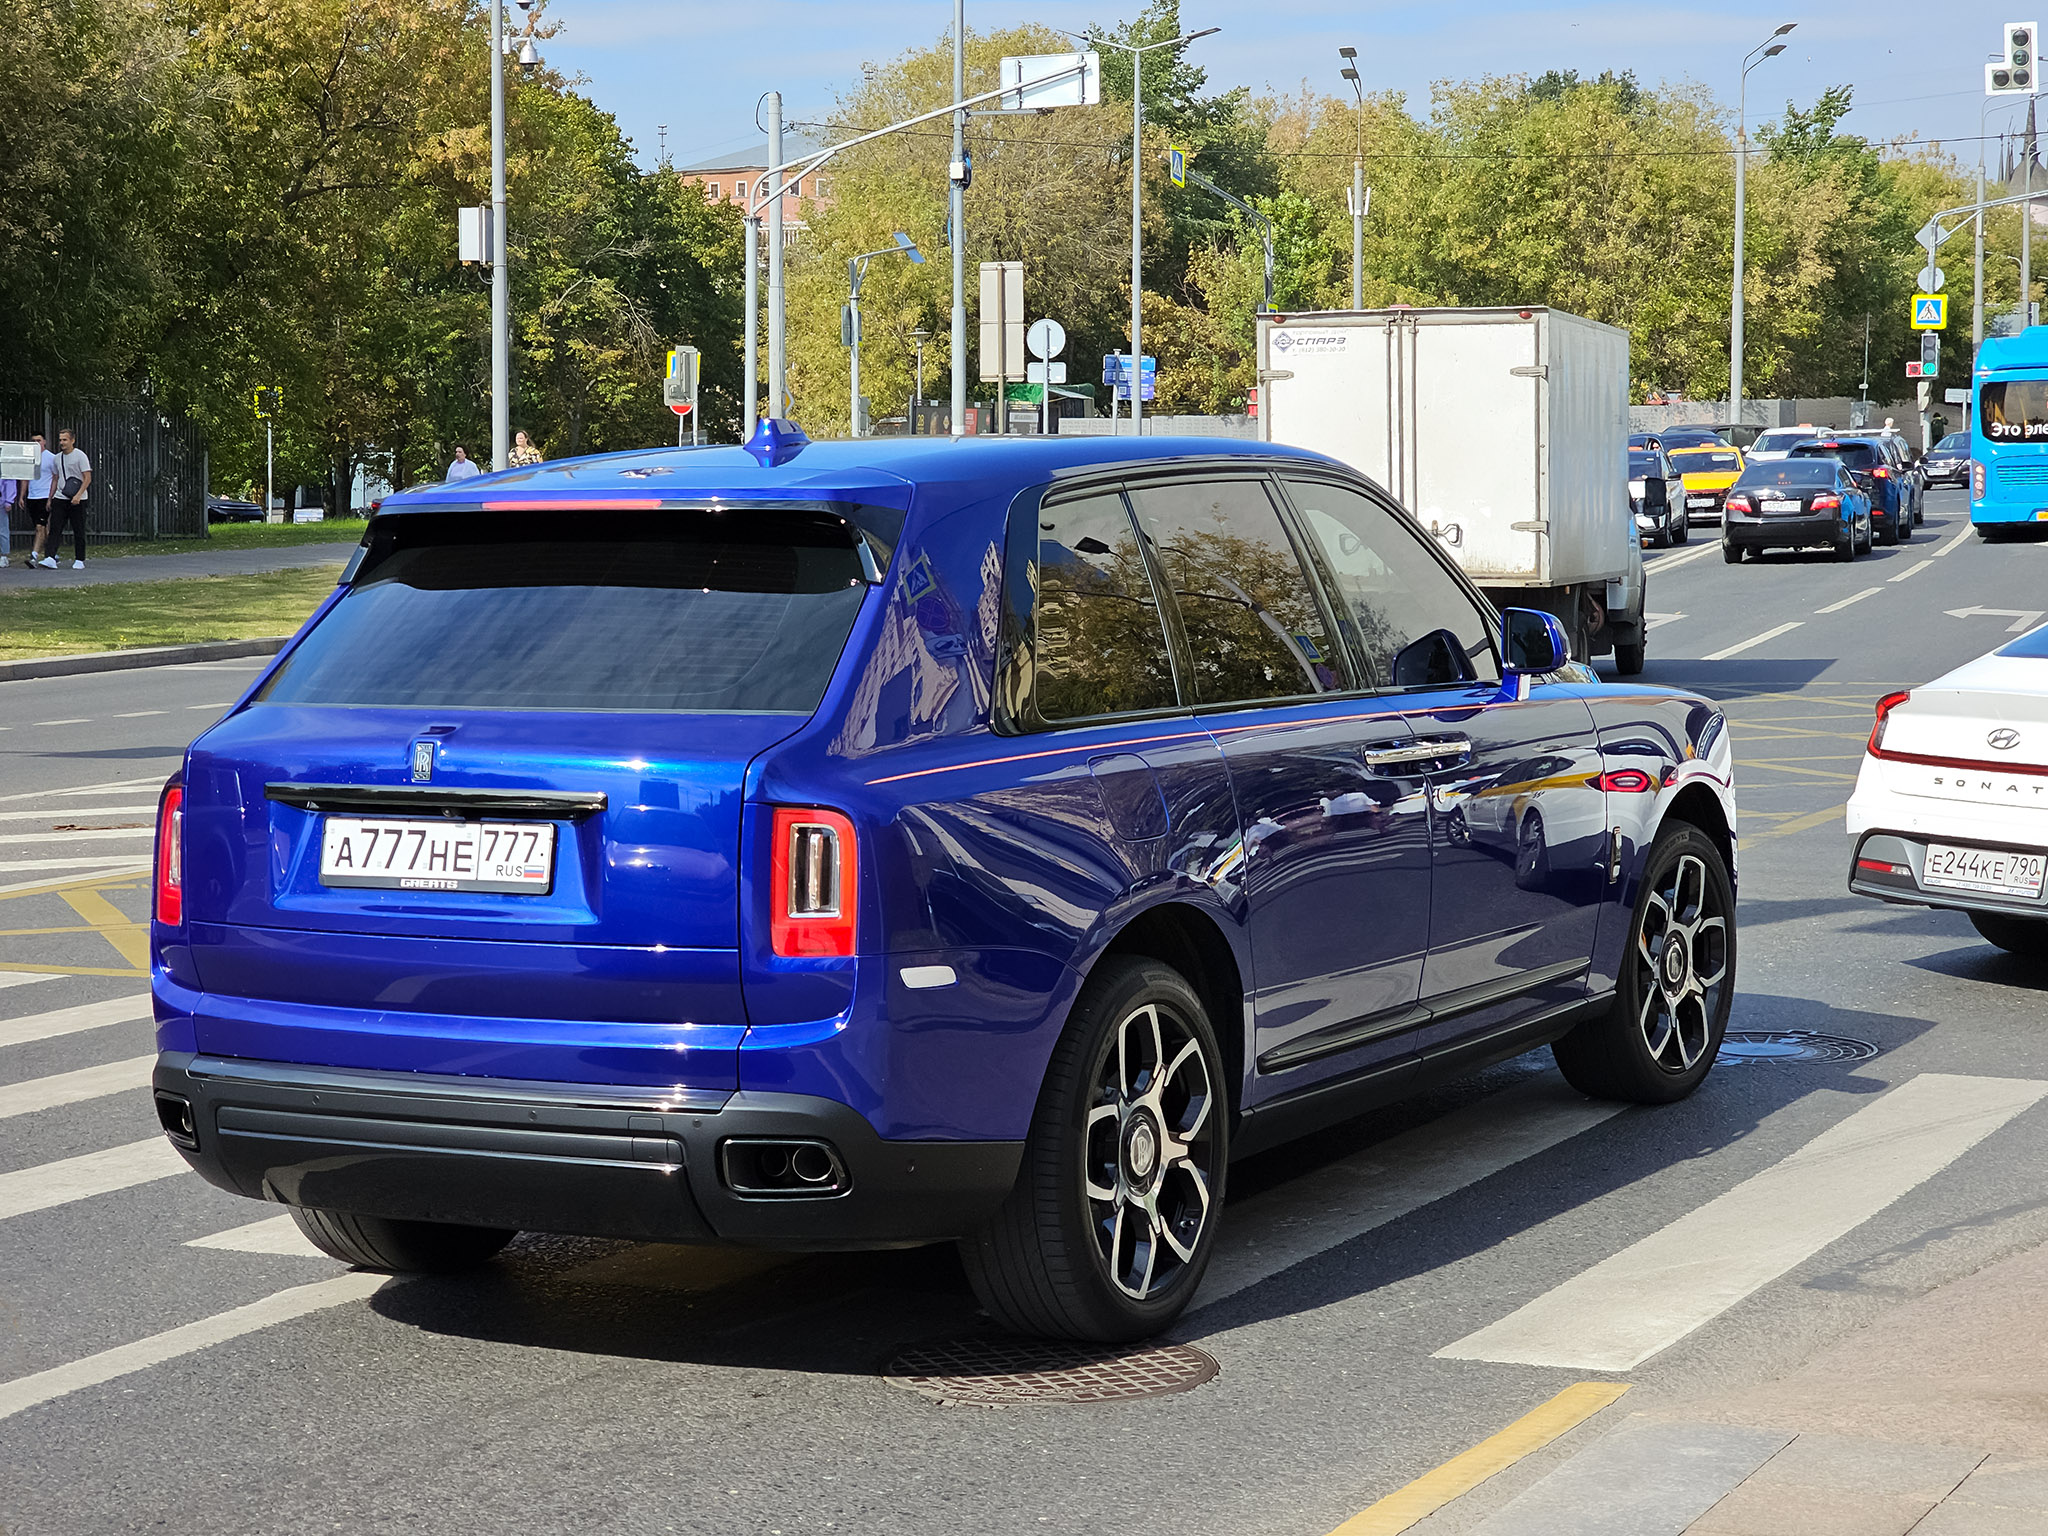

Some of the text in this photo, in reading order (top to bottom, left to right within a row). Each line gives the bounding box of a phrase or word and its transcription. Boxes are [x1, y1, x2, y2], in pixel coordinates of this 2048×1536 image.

[1296, 337, 1346, 345] СПАРЗ
[1991, 422, 2021, 437] Это
[484, 830, 539, 863] 777
[496, 865, 523, 878] RUS
[2009, 856, 2039, 876] 790
[400, 879, 458, 889] GREATS
[2013, 876, 2029, 884] RUS
